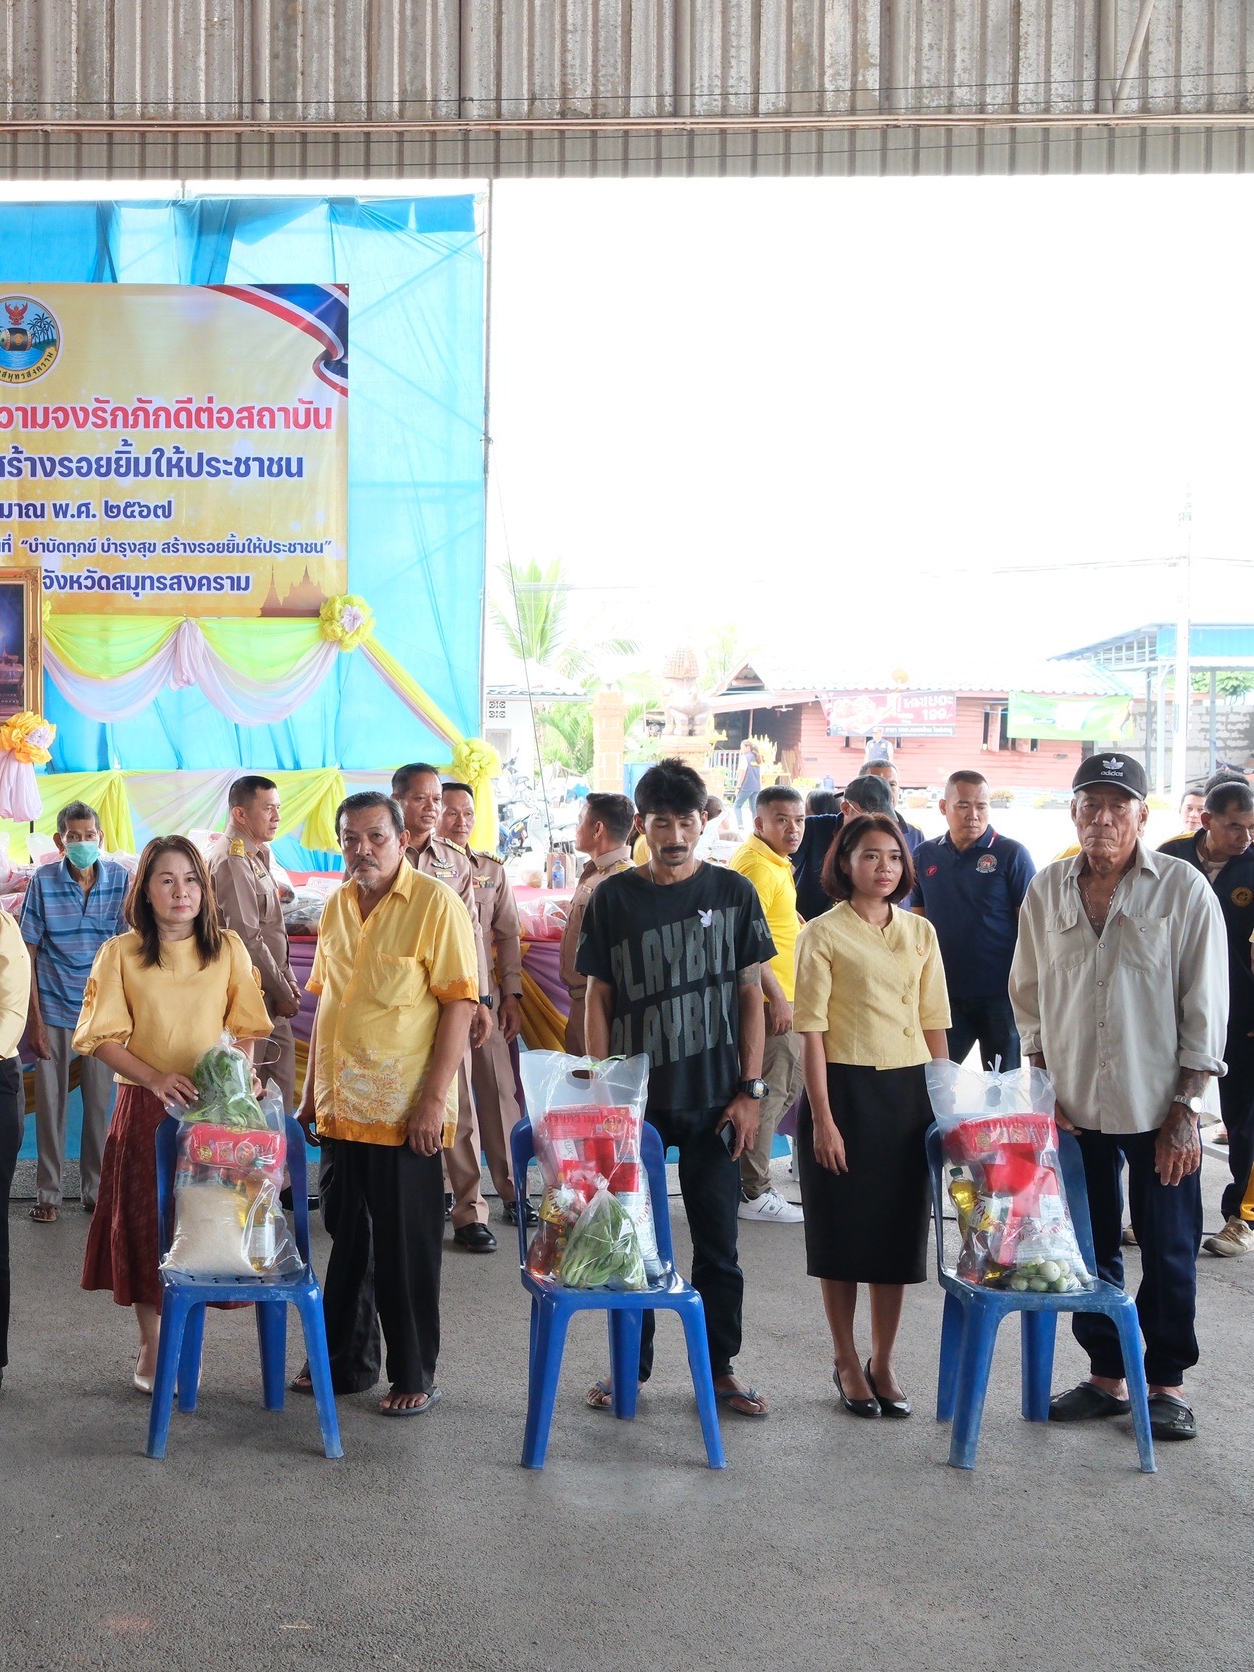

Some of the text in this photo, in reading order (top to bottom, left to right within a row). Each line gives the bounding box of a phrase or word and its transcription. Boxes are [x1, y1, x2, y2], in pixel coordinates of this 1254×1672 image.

[52, 500, 97, 519] พ.ศ.
[103, 499, 173, 519] ๒๕๖๗
[100, 537, 157, 558] บำรุงสุข
[42, 568, 250, 597] จังหวัดสมุทรสงคราม
[1100, 769, 1124, 777] adidas
